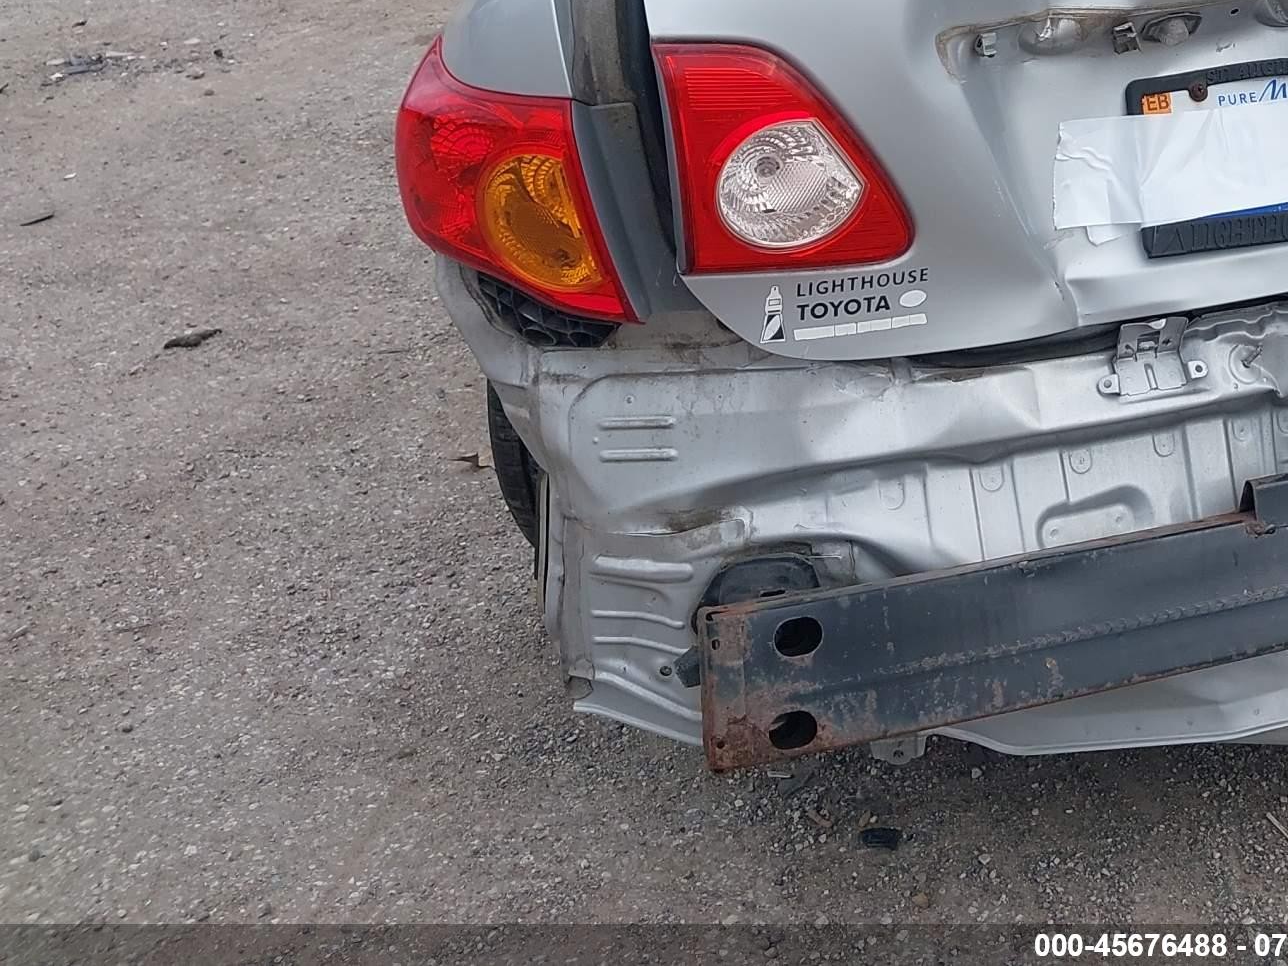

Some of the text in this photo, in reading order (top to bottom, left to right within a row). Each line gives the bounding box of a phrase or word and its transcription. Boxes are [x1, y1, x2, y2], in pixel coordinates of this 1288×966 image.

[1145, 94, 1169, 111] EB
[1218, 92, 1259, 107] PURE
[797, 268, 929, 297] LIGHTHOUSE
[797, 295, 890, 321] TOYOTA
